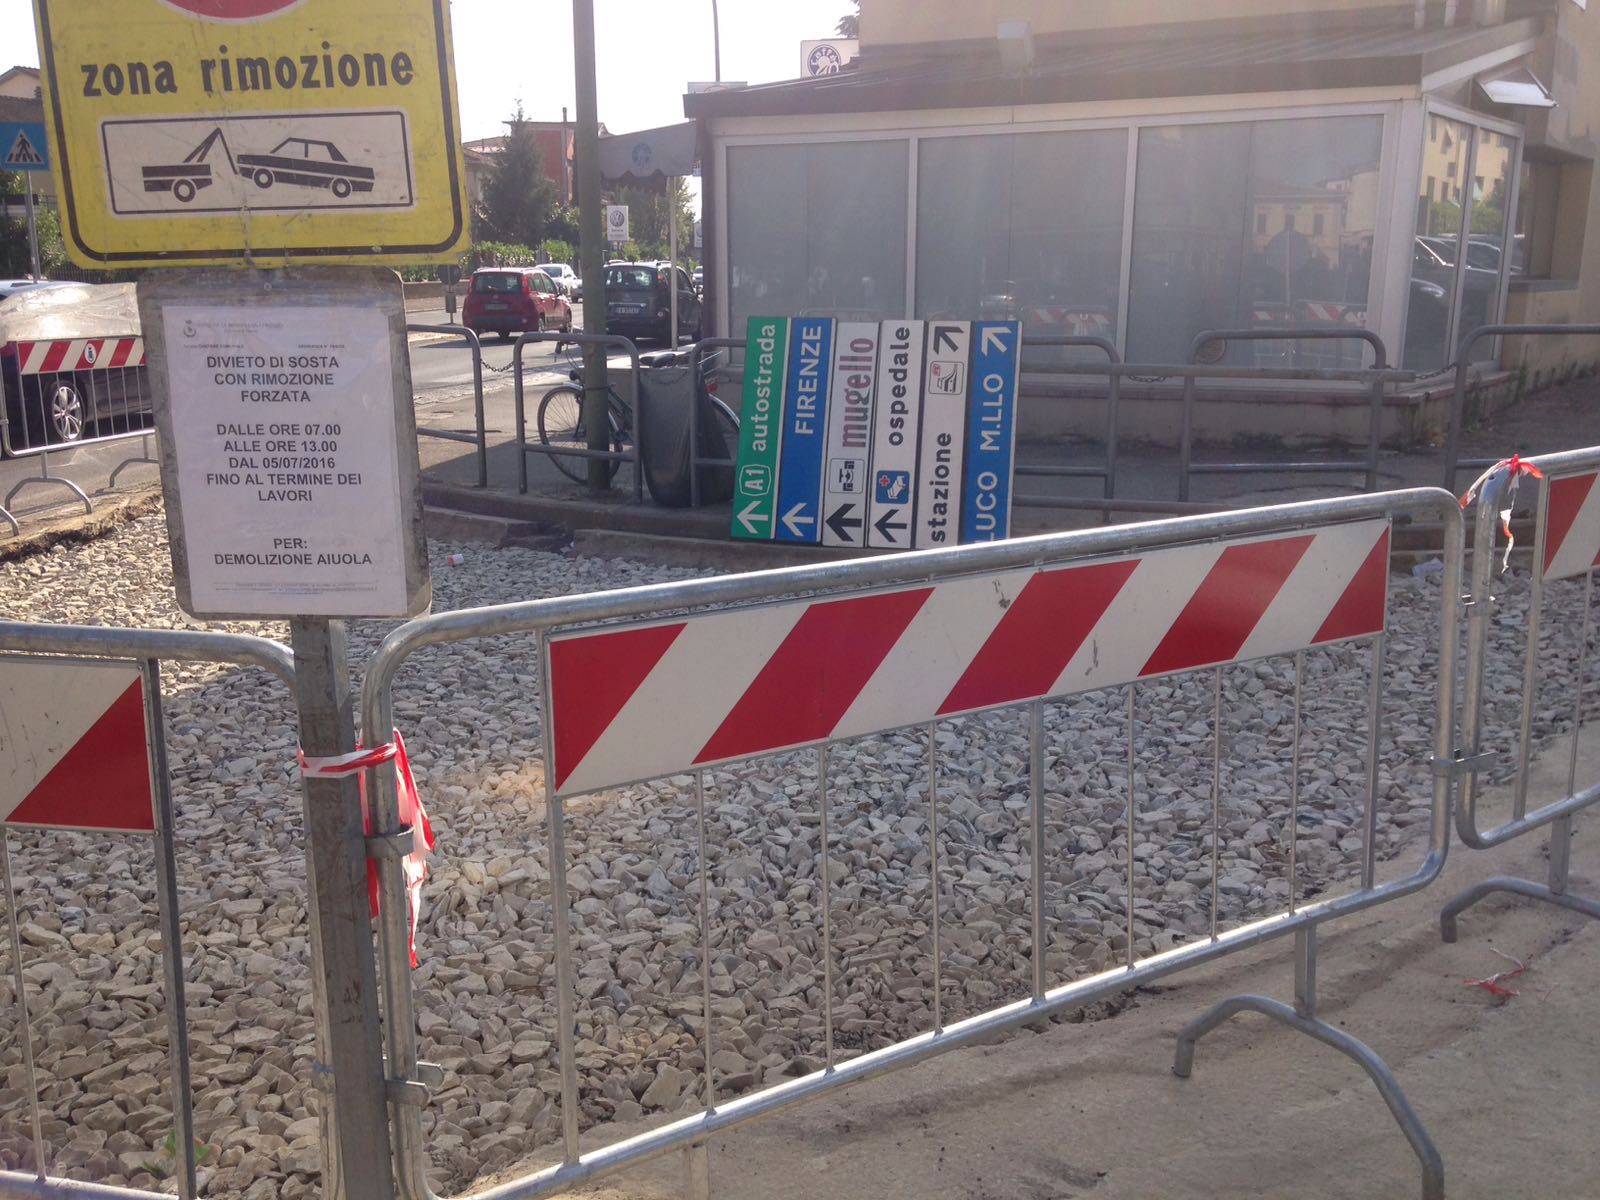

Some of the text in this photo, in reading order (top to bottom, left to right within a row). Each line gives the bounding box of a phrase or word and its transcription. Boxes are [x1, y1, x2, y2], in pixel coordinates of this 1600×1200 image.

[81, 41, 413, 97] zona rimozione
[207, 357, 339, 368] DIVIETO DI SOSTA
[214, 374, 333, 385] CON RIMOZIONE
[795, 326, 822, 434] FIRENZE
[888, 327, 910, 446] ospedale
[241, 391, 310, 402] FORZATA
[839, 338, 874, 448] mugello
[744, 324, 775, 490] A1 autostrada
[217, 424, 341, 435] DALLE ORE 07.00
[224, 441, 337, 452] ALLE ORE 13.00
[229, 457, 335, 469] DAL 05/07/2016
[974, 374, 1003, 544] LUCO M.LLO
[207, 474, 361, 485] FINO AL TERMINE DEI
[928, 433, 951, 542] stazione
[259, 490, 312, 501] LAVORI
[274, 538, 307, 549] PER:
[215, 554, 372, 565] DEMOLIZIONE AIUOLA
